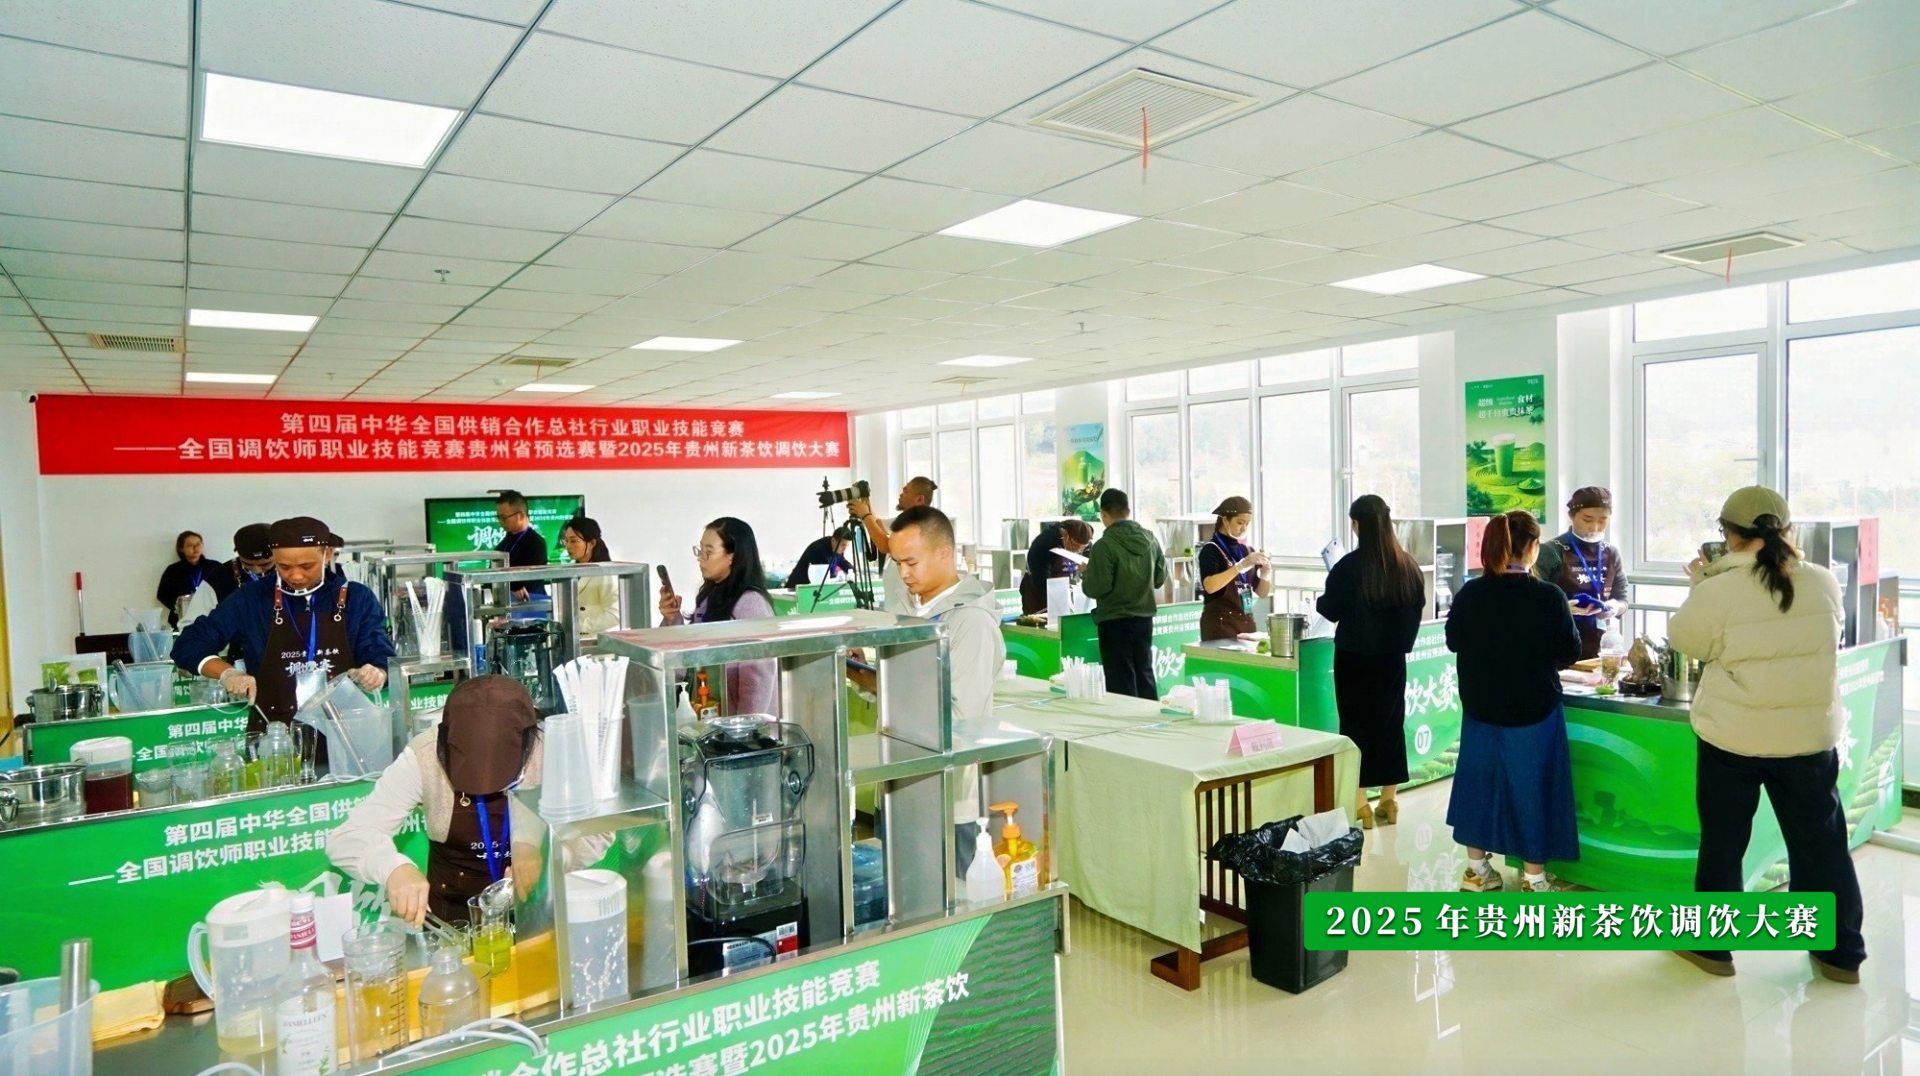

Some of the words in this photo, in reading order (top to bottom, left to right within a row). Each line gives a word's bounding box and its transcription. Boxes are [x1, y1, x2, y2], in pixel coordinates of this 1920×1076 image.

[280, 412, 745, 439] 第四届中华全国供销合作总社行业职业技能竞赛
[1417, 730, 1430, 749] 07
